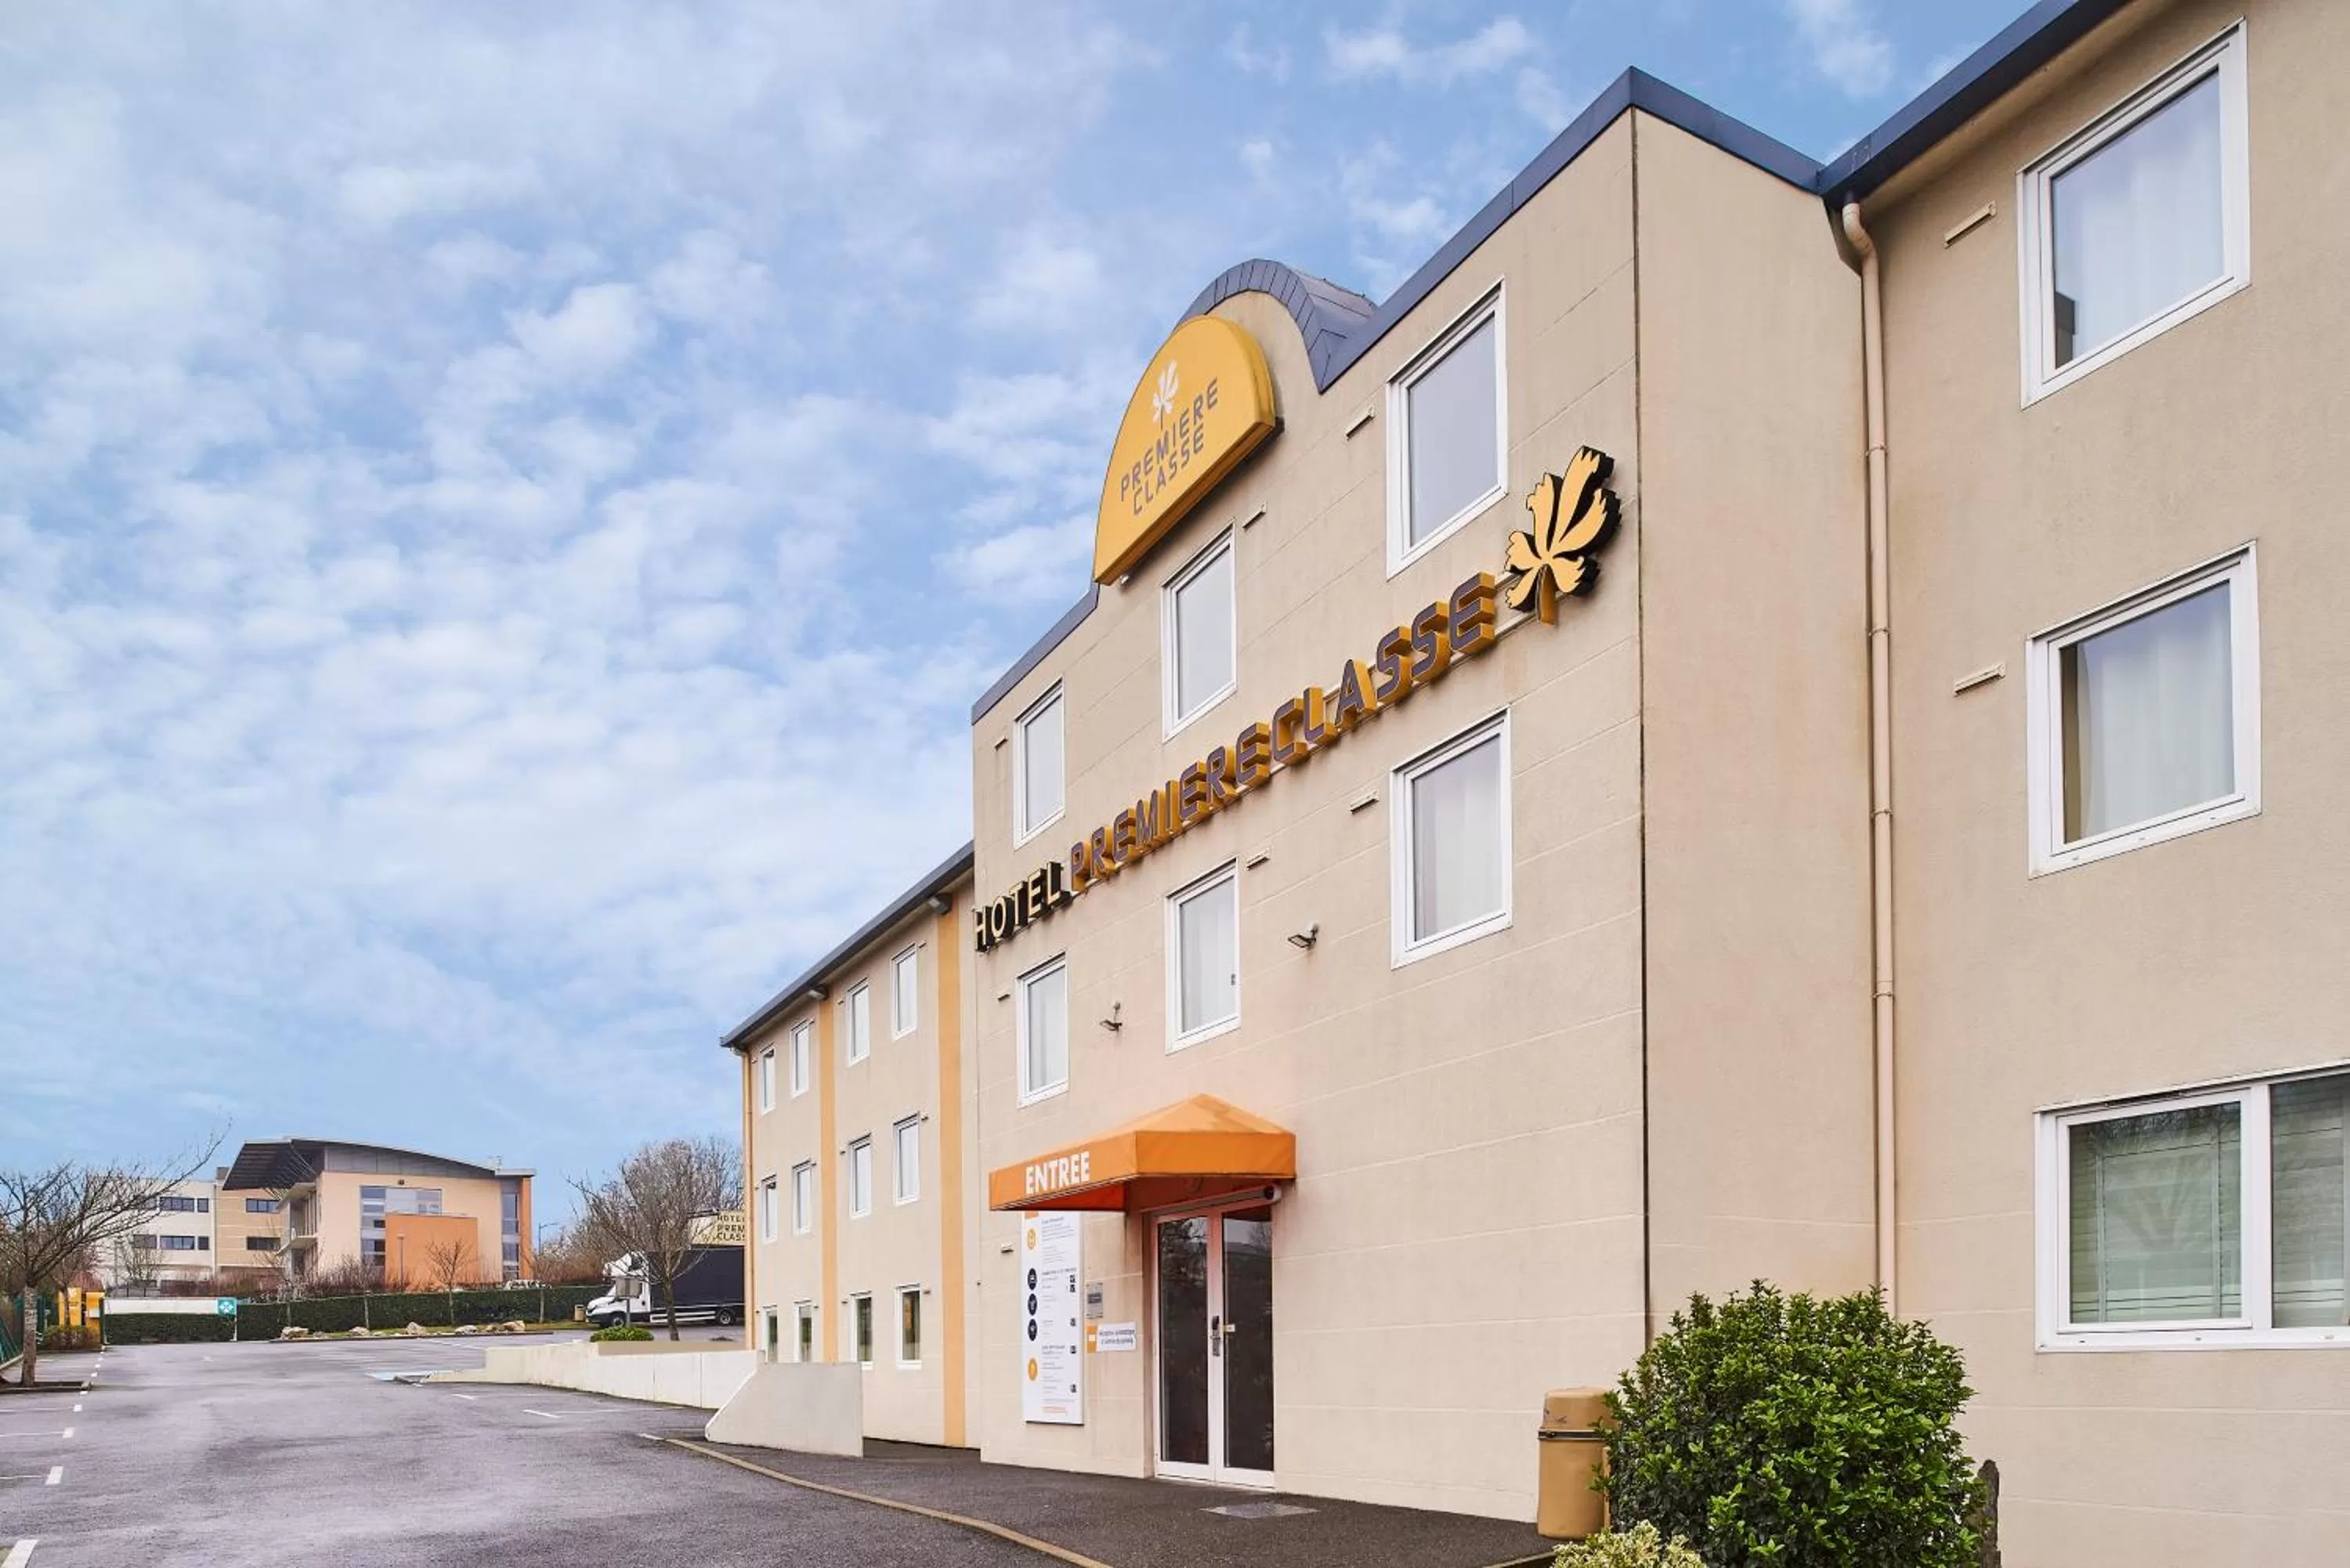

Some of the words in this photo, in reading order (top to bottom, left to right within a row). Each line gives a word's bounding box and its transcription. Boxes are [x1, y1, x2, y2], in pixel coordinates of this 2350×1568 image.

[1120, 378, 1219, 501] PREMIERE
[1133, 429, 1204, 515] CLASSE
[974, 861, 1071, 952] HOTEL
[1025, 1151, 1090, 1194] ENTREE
